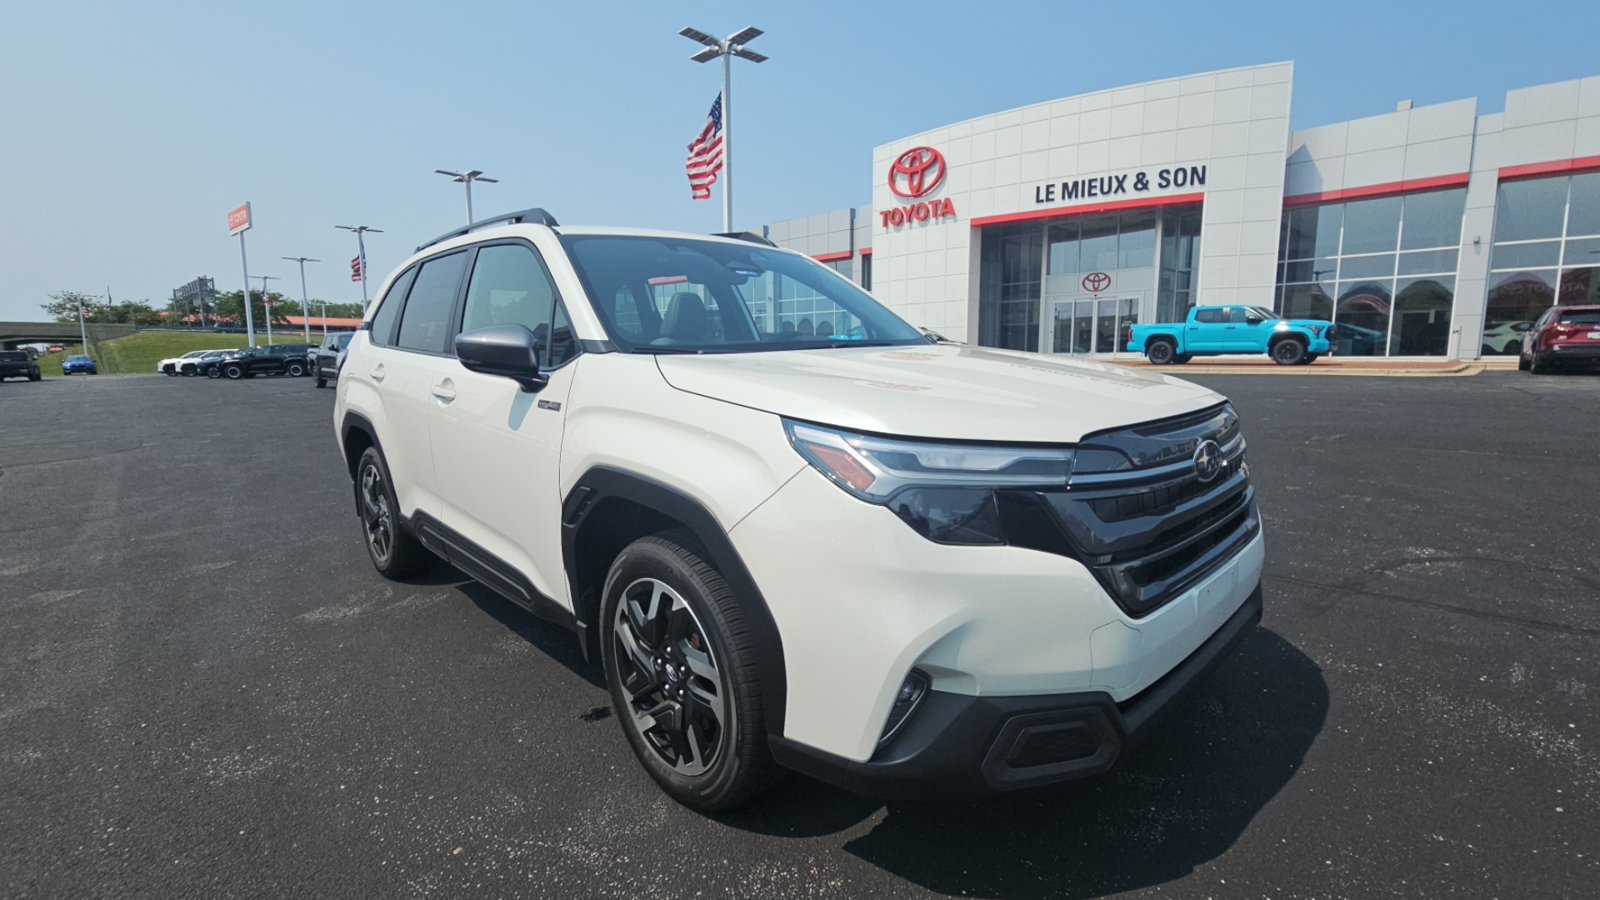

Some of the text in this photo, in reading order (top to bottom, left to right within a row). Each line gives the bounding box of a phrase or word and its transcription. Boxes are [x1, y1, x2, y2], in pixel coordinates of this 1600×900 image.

[1035, 165, 1207, 204] LE MIEUX & SON
[879, 197, 957, 228] TOYOTA
